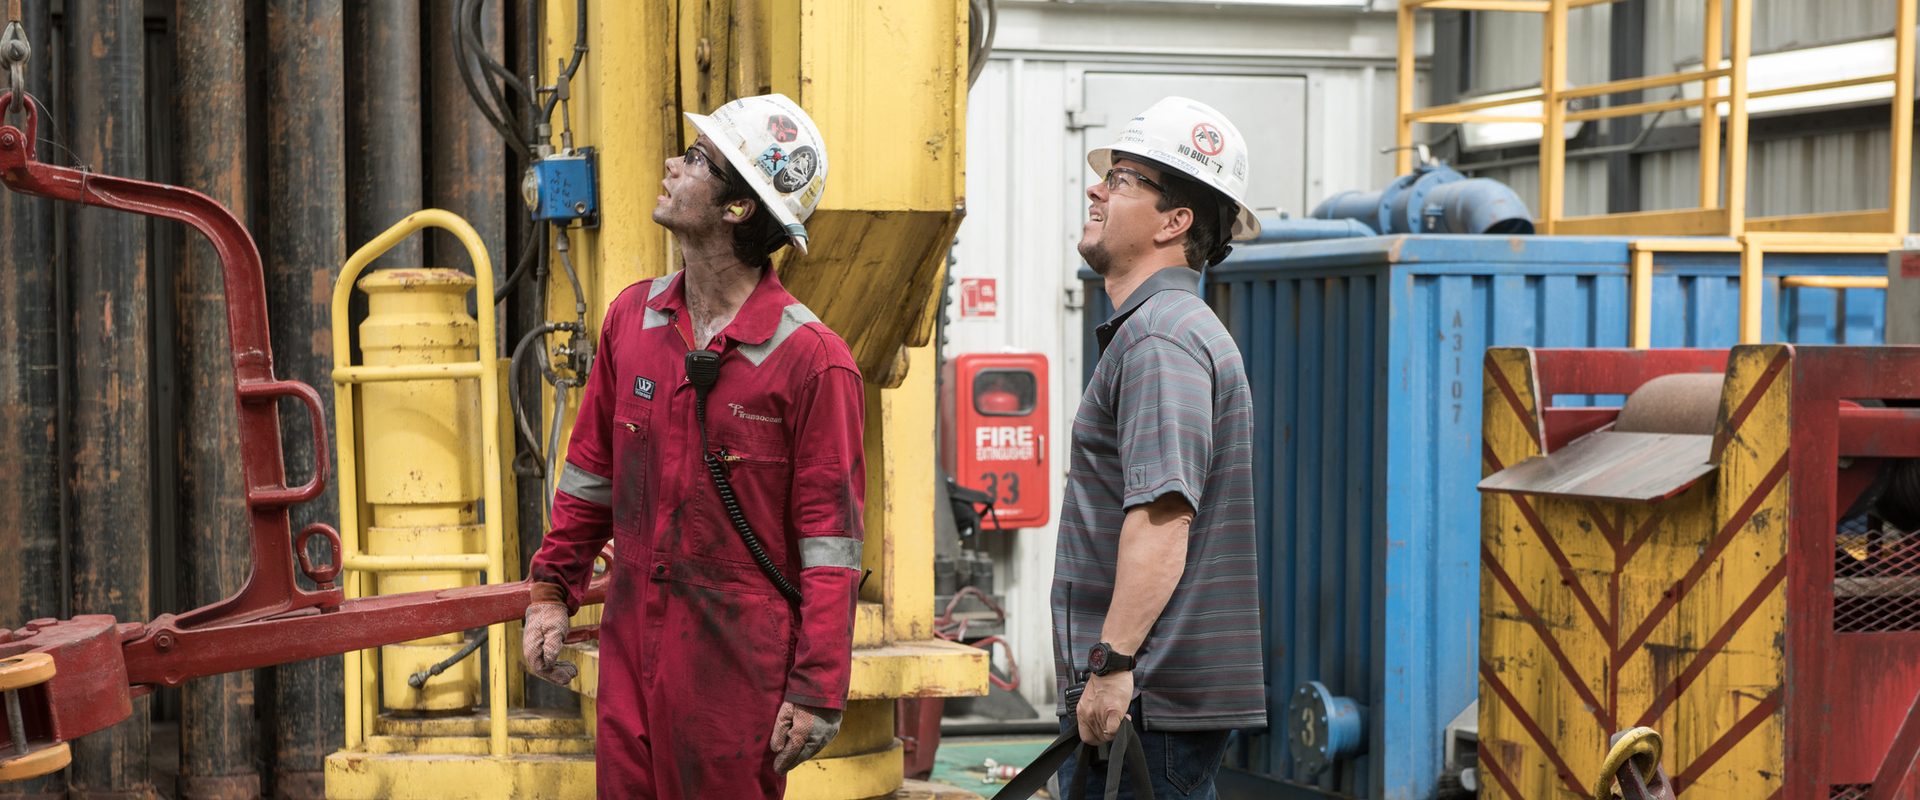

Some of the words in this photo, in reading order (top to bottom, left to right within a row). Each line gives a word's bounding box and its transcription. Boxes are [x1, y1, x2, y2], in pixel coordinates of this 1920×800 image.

[1177, 144, 1191, 156] NO
[1190, 149, 1210, 167] BULL
[1451, 309, 1463, 424] A3107
[737, 409, 783, 424] Transocean
[976, 426, 1033, 448] FIRE
[981, 471, 1020, 505] 33
[1302, 707, 1315, 748] 3
